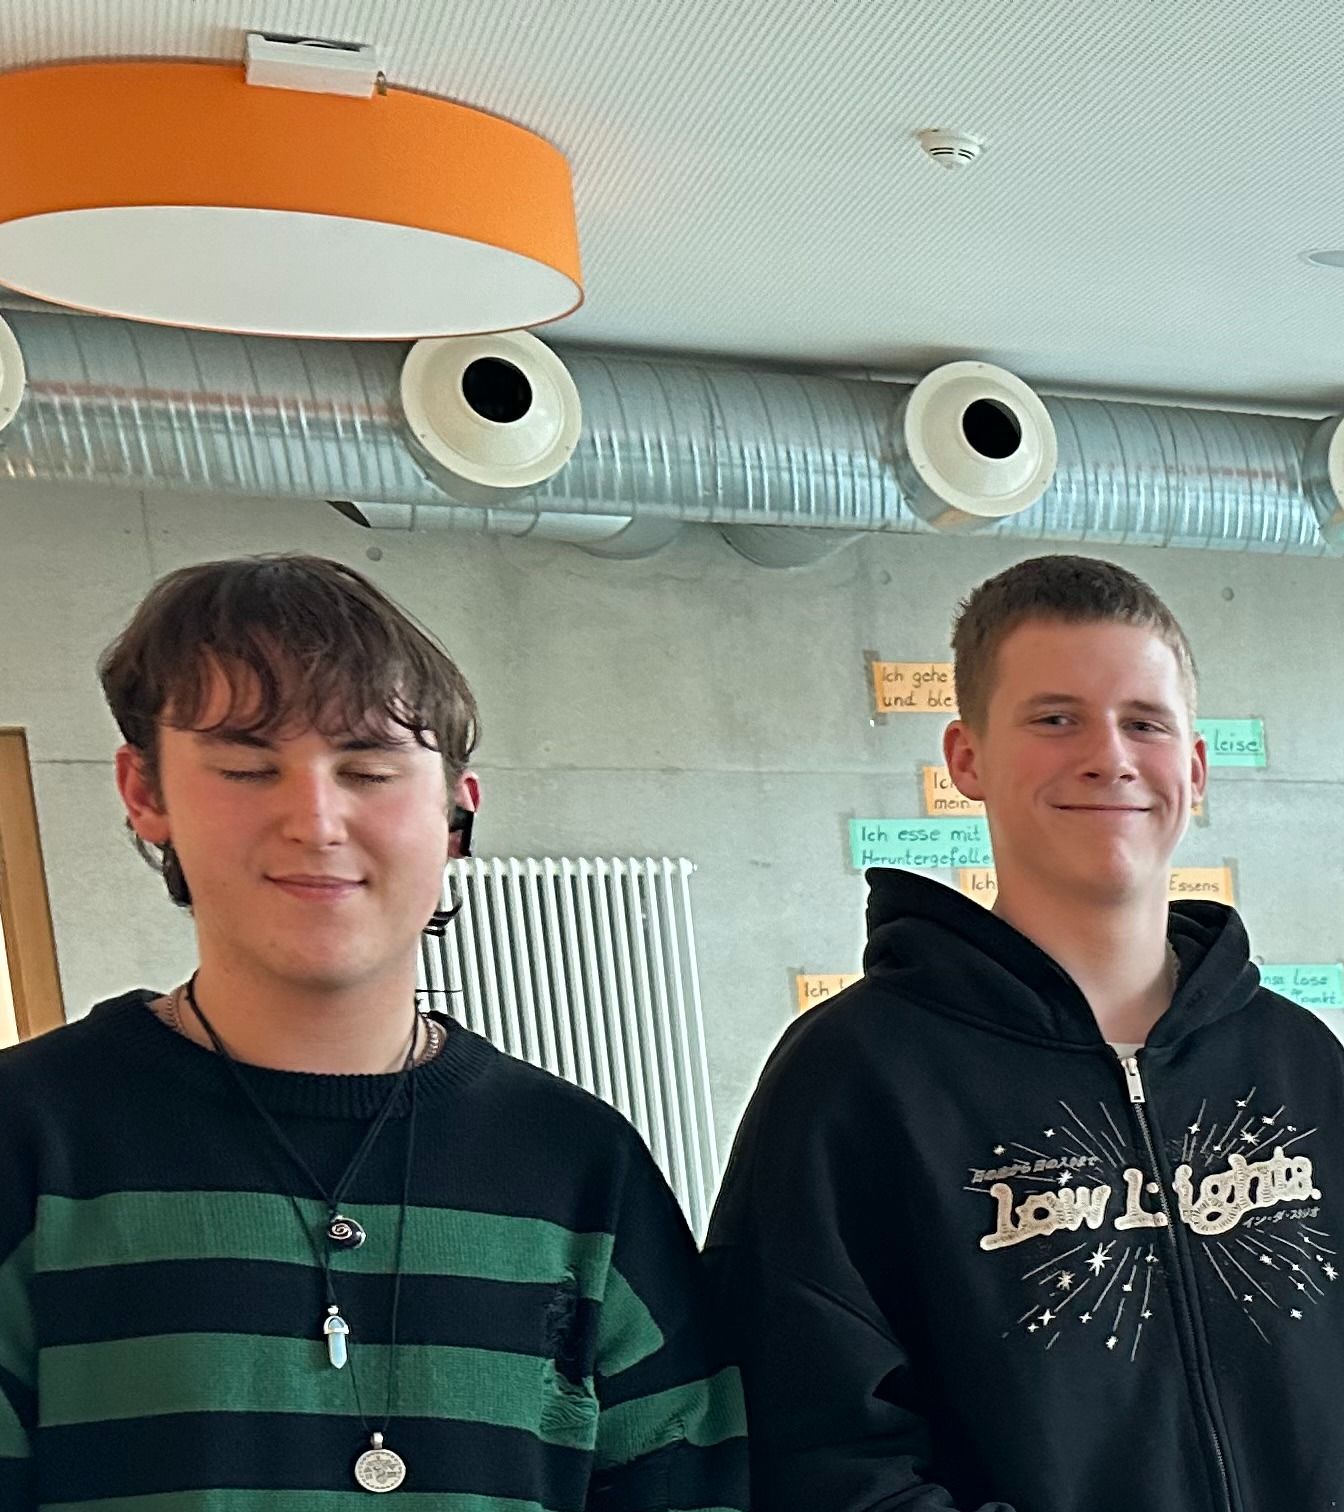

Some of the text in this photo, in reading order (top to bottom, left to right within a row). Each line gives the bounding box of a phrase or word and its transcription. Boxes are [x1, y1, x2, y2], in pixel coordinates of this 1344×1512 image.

[882, 664, 949, 688] Ich gehe
[883, 688, 917, 707] und
[1214, 729, 1260, 752] leise
[861, 825, 981, 842] Ich esse mit
[971, 873, 996, 891] Ich
[1169, 874, 1220, 892] Essens
[804, 981, 830, 998] Ich
